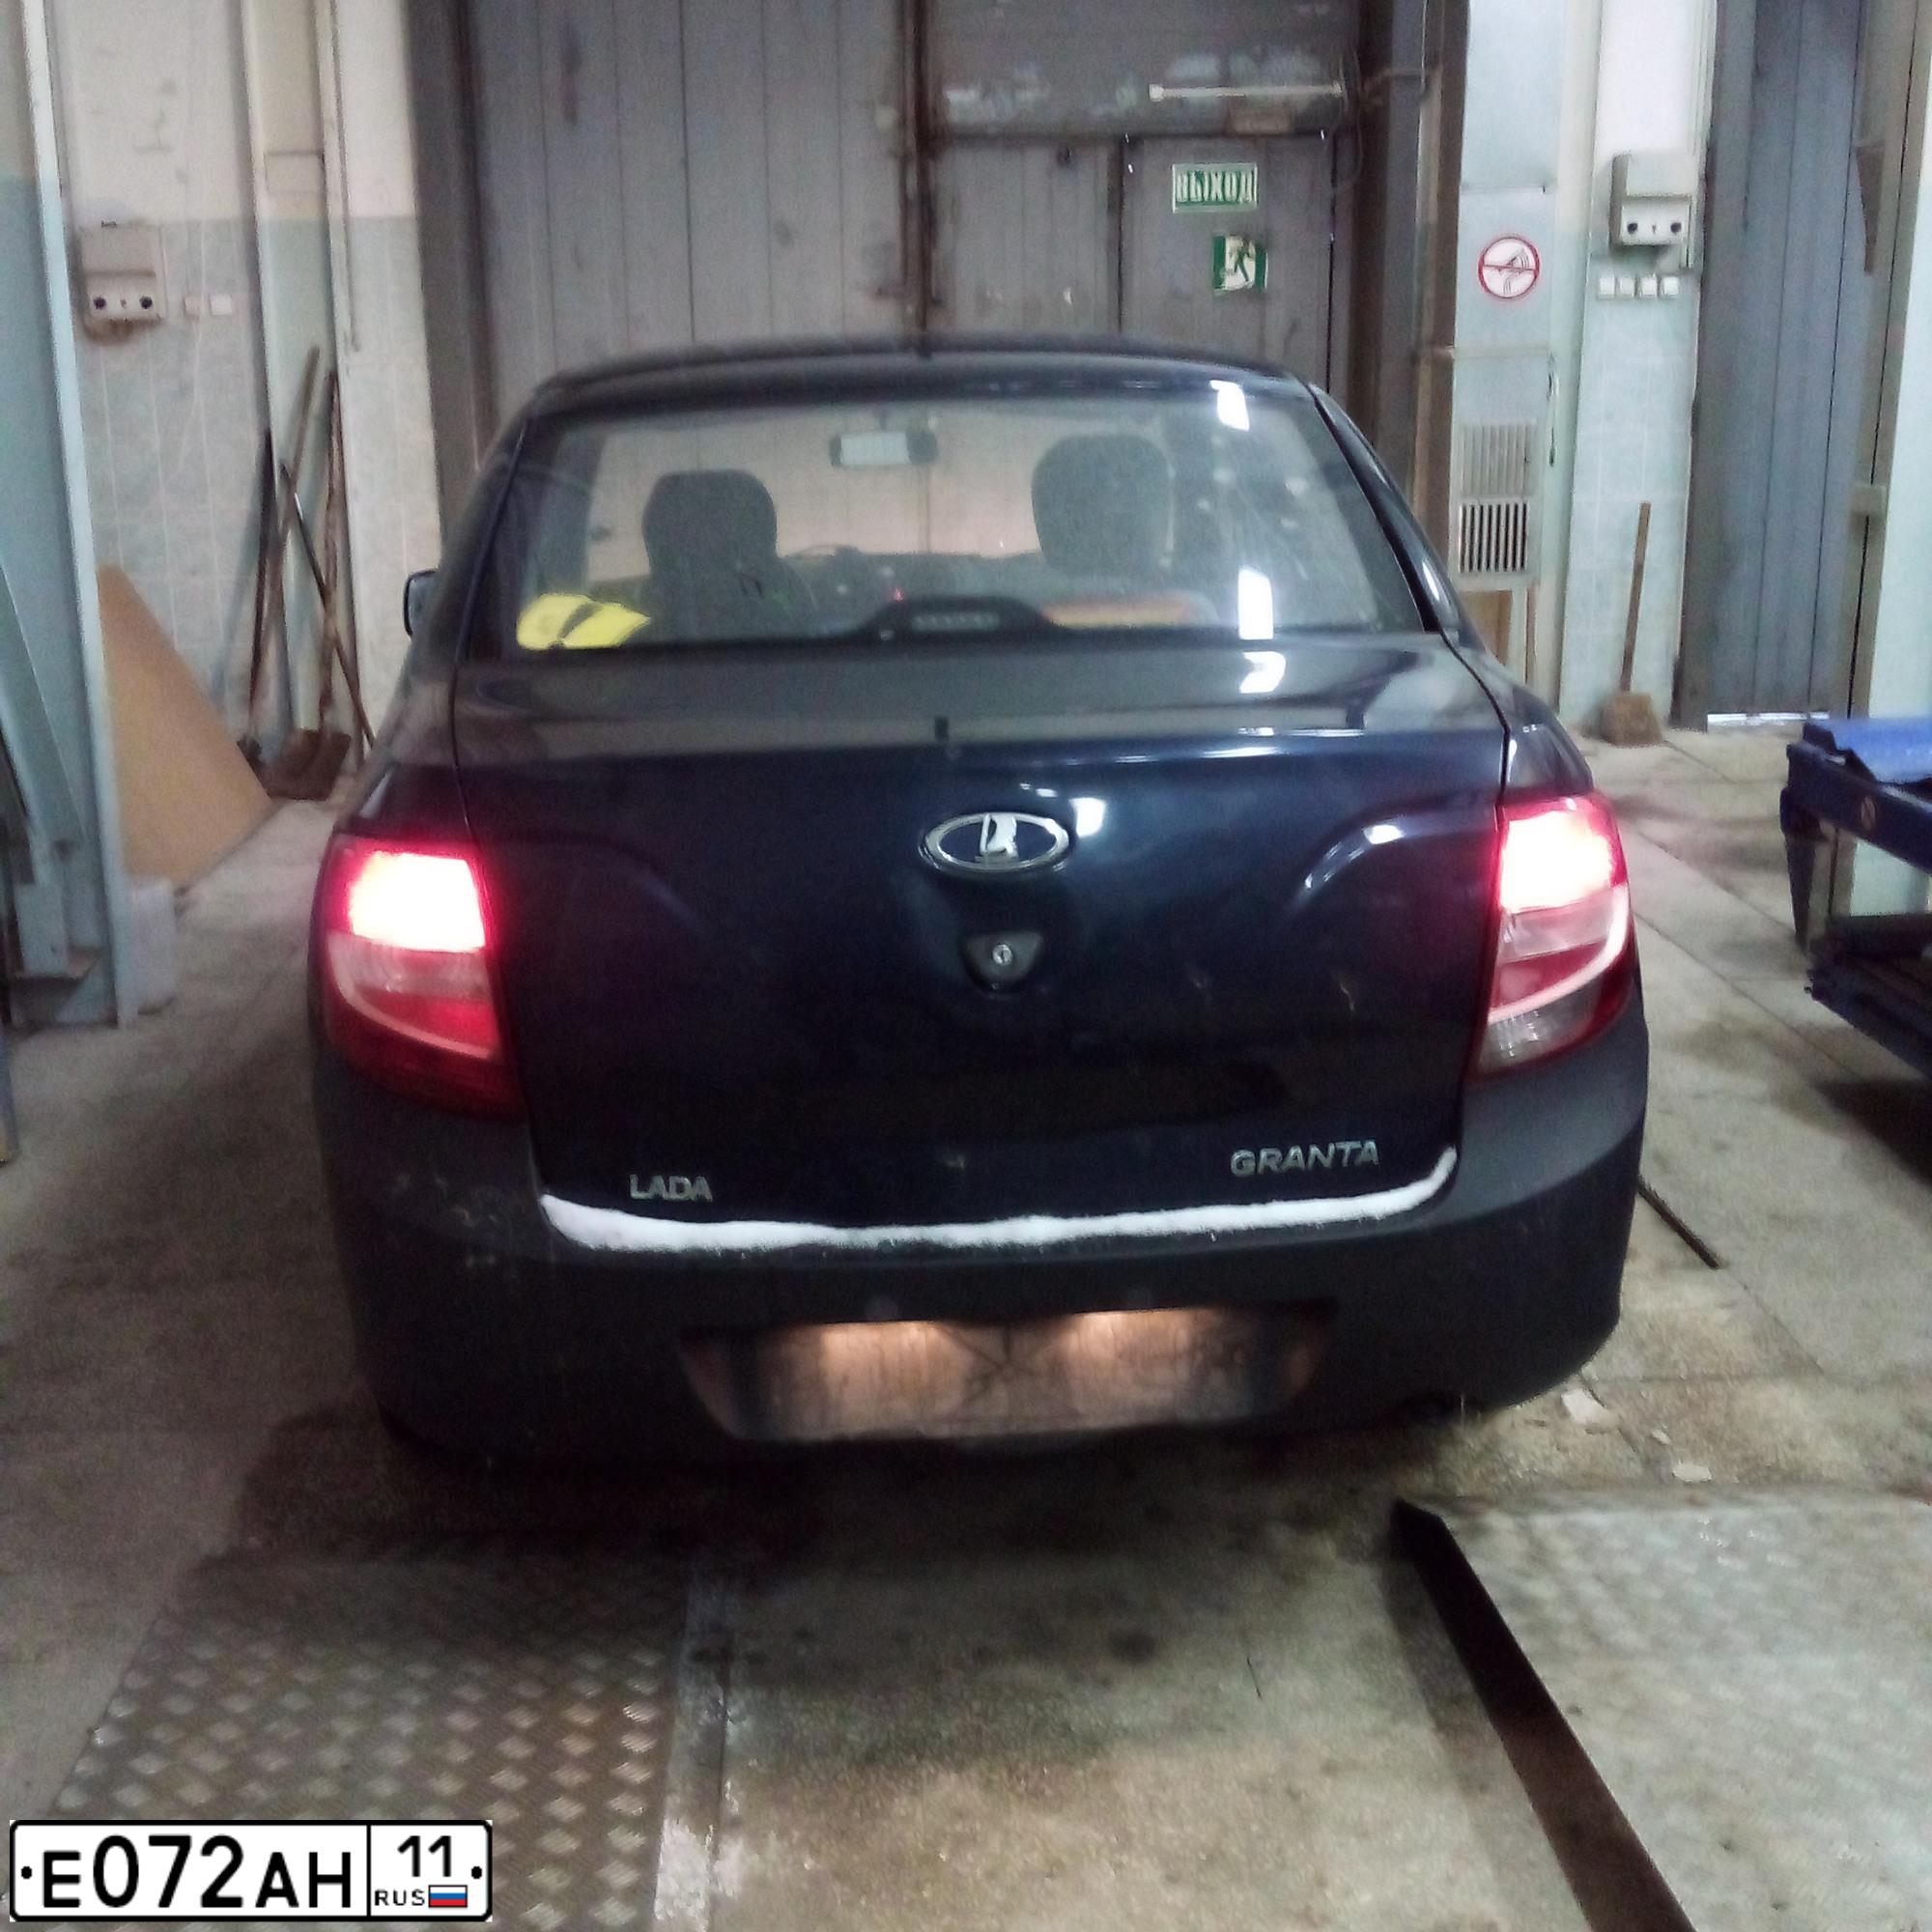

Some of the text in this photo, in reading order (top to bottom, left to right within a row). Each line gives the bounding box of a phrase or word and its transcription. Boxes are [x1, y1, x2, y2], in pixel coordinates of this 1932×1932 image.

[1175, 168, 1254, 204] ВЫХОД
[1230, 1140, 1379, 1177] GRANTA
[629, 1174, 713, 1202] LADA
